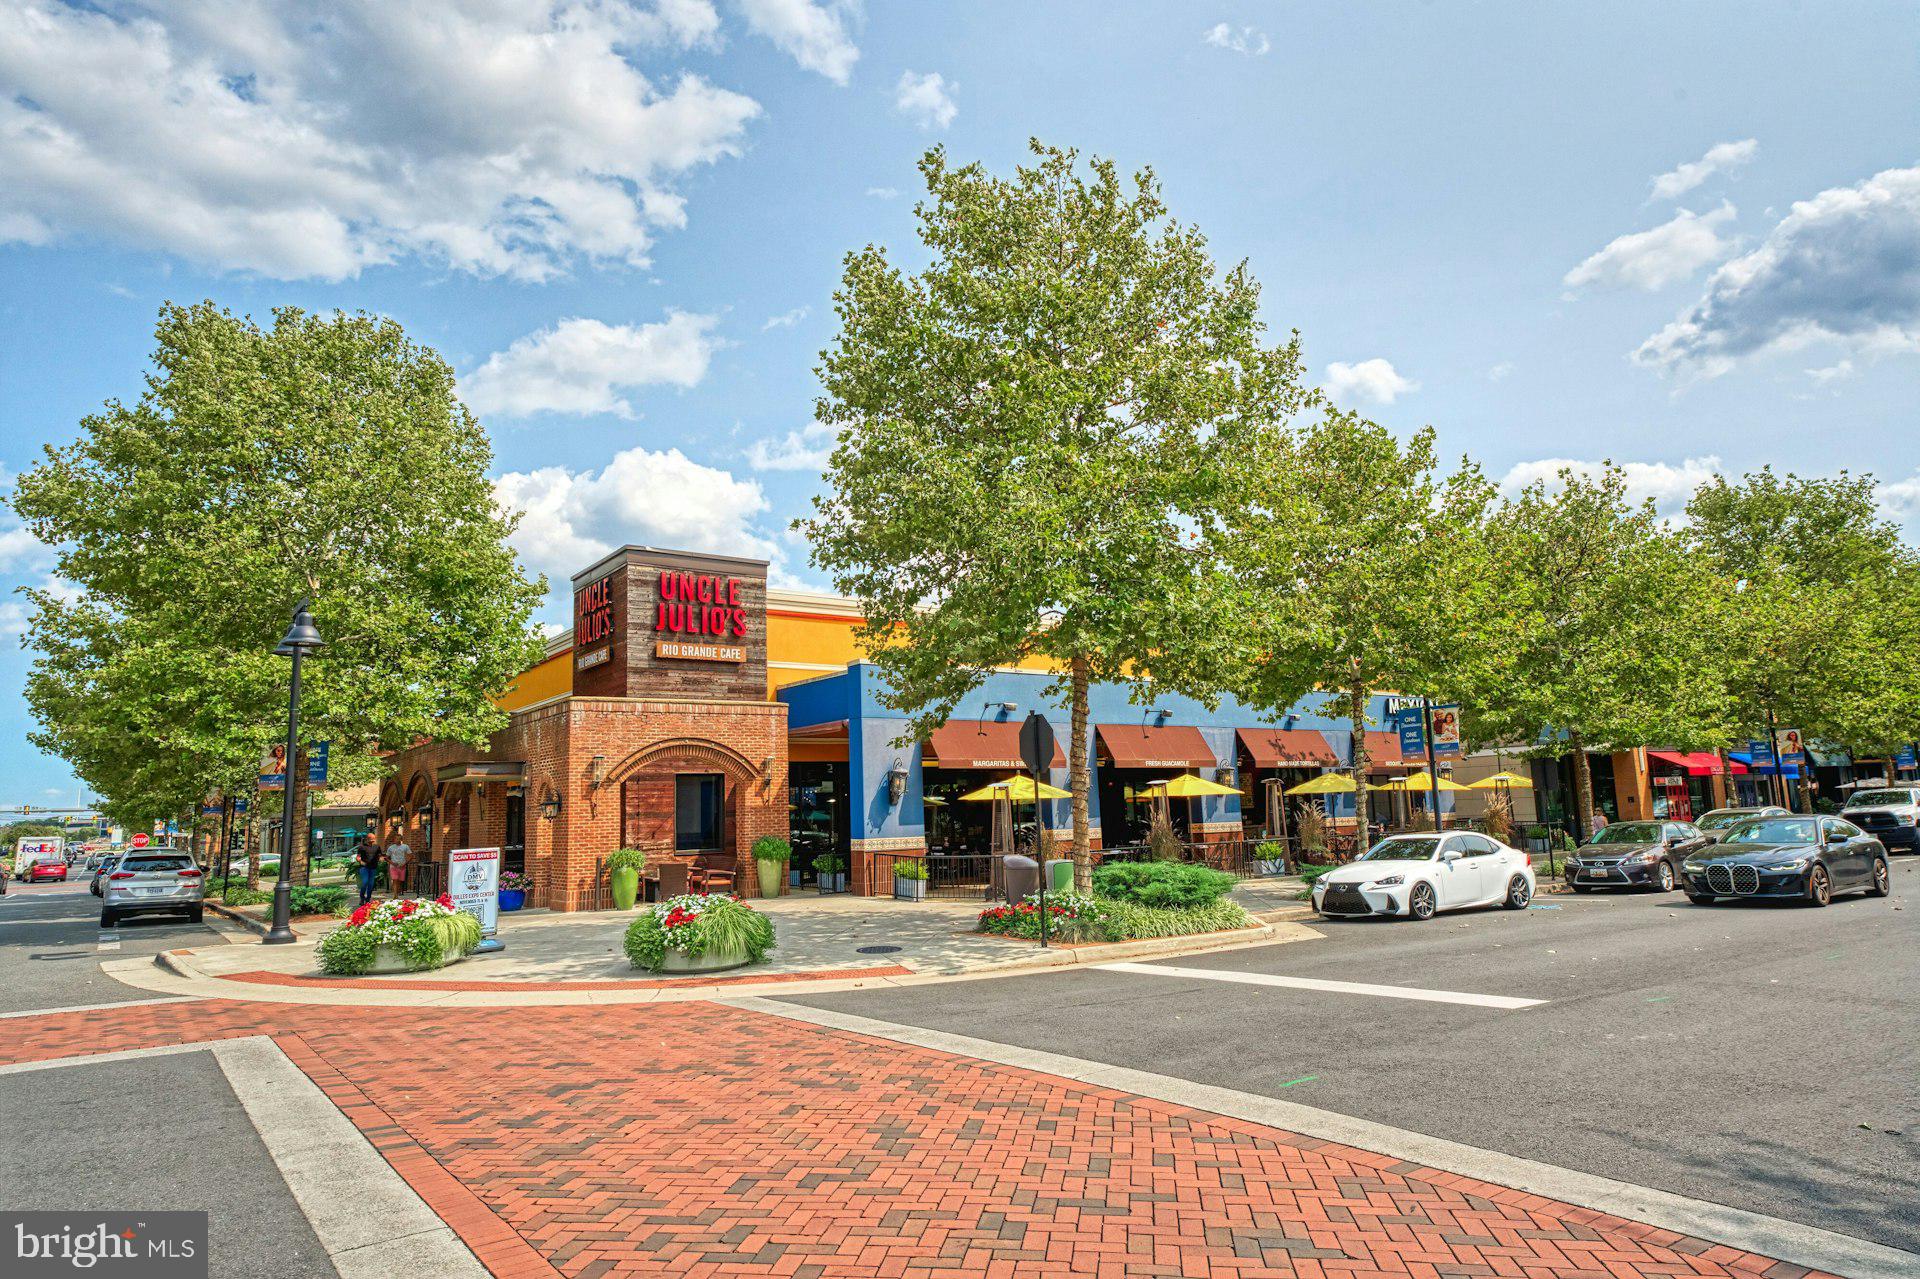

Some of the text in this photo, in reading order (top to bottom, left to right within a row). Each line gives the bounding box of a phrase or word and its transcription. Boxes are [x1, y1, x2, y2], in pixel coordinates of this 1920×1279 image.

[579, 577, 608, 616] UNCLE
[661, 569, 741, 606] UNCLE
[577, 607, 610, 645] JULIO'S
[655, 602, 746, 636] JULIO'S
[662, 643, 741, 659] RIO GRANDE CAFE
[20, 843, 56, 853] FedEx
[453, 853, 469, 861] SCAN
